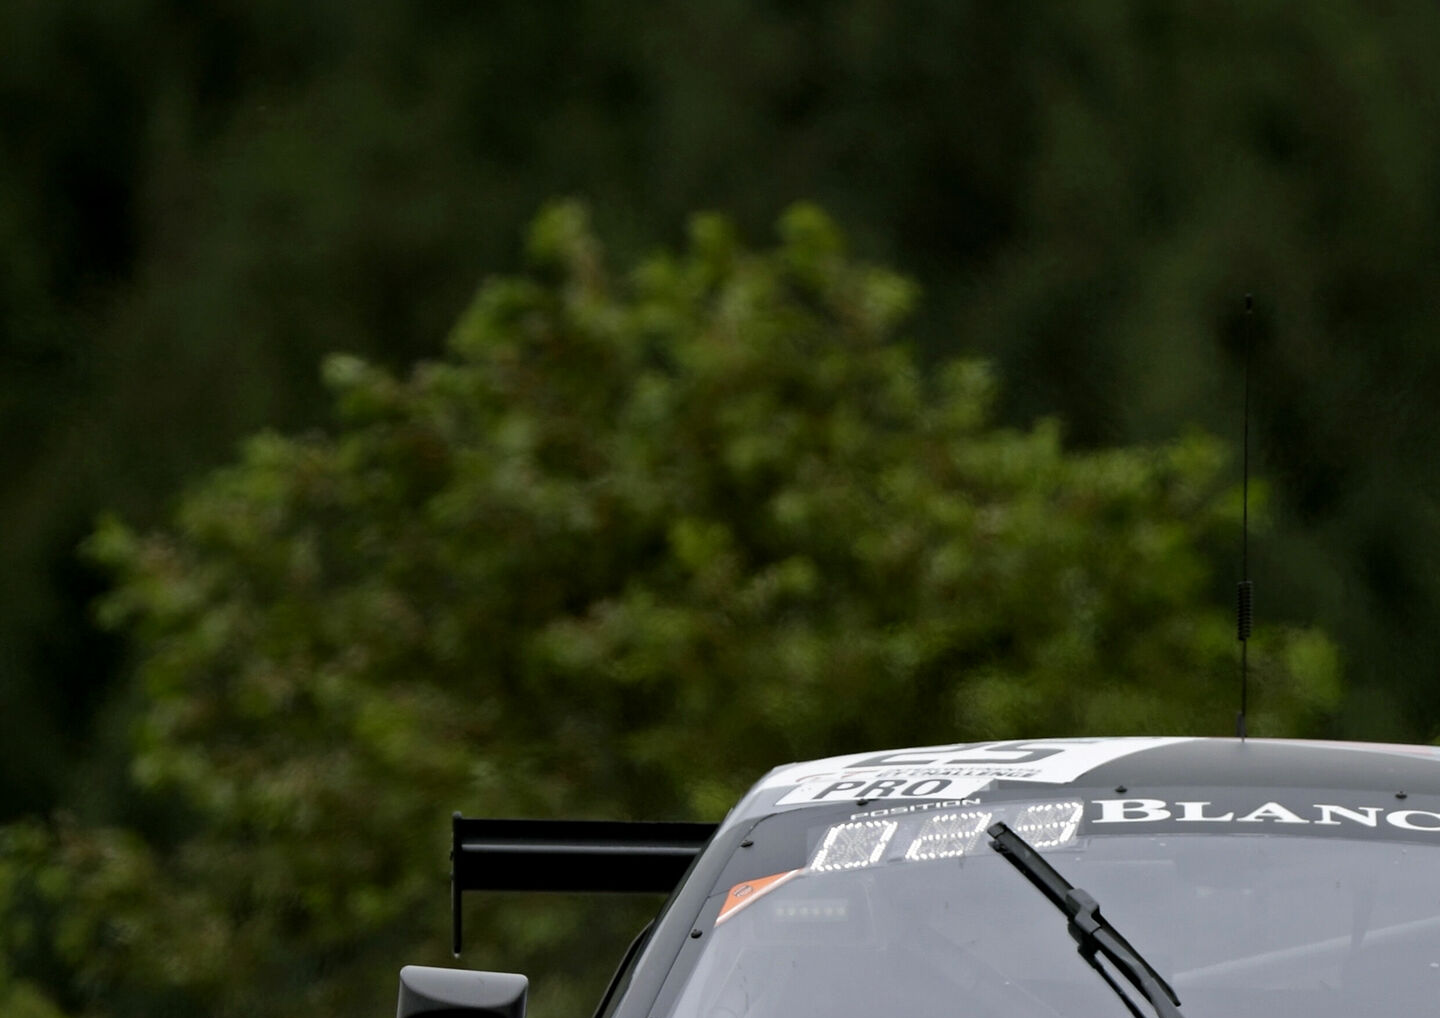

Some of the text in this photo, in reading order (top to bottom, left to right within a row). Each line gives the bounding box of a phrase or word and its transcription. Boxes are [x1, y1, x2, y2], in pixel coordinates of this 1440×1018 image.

[846, 741, 1092, 768] 25
[812, 778, 953, 800] PRO
[851, 798, 981, 821] POSITION
